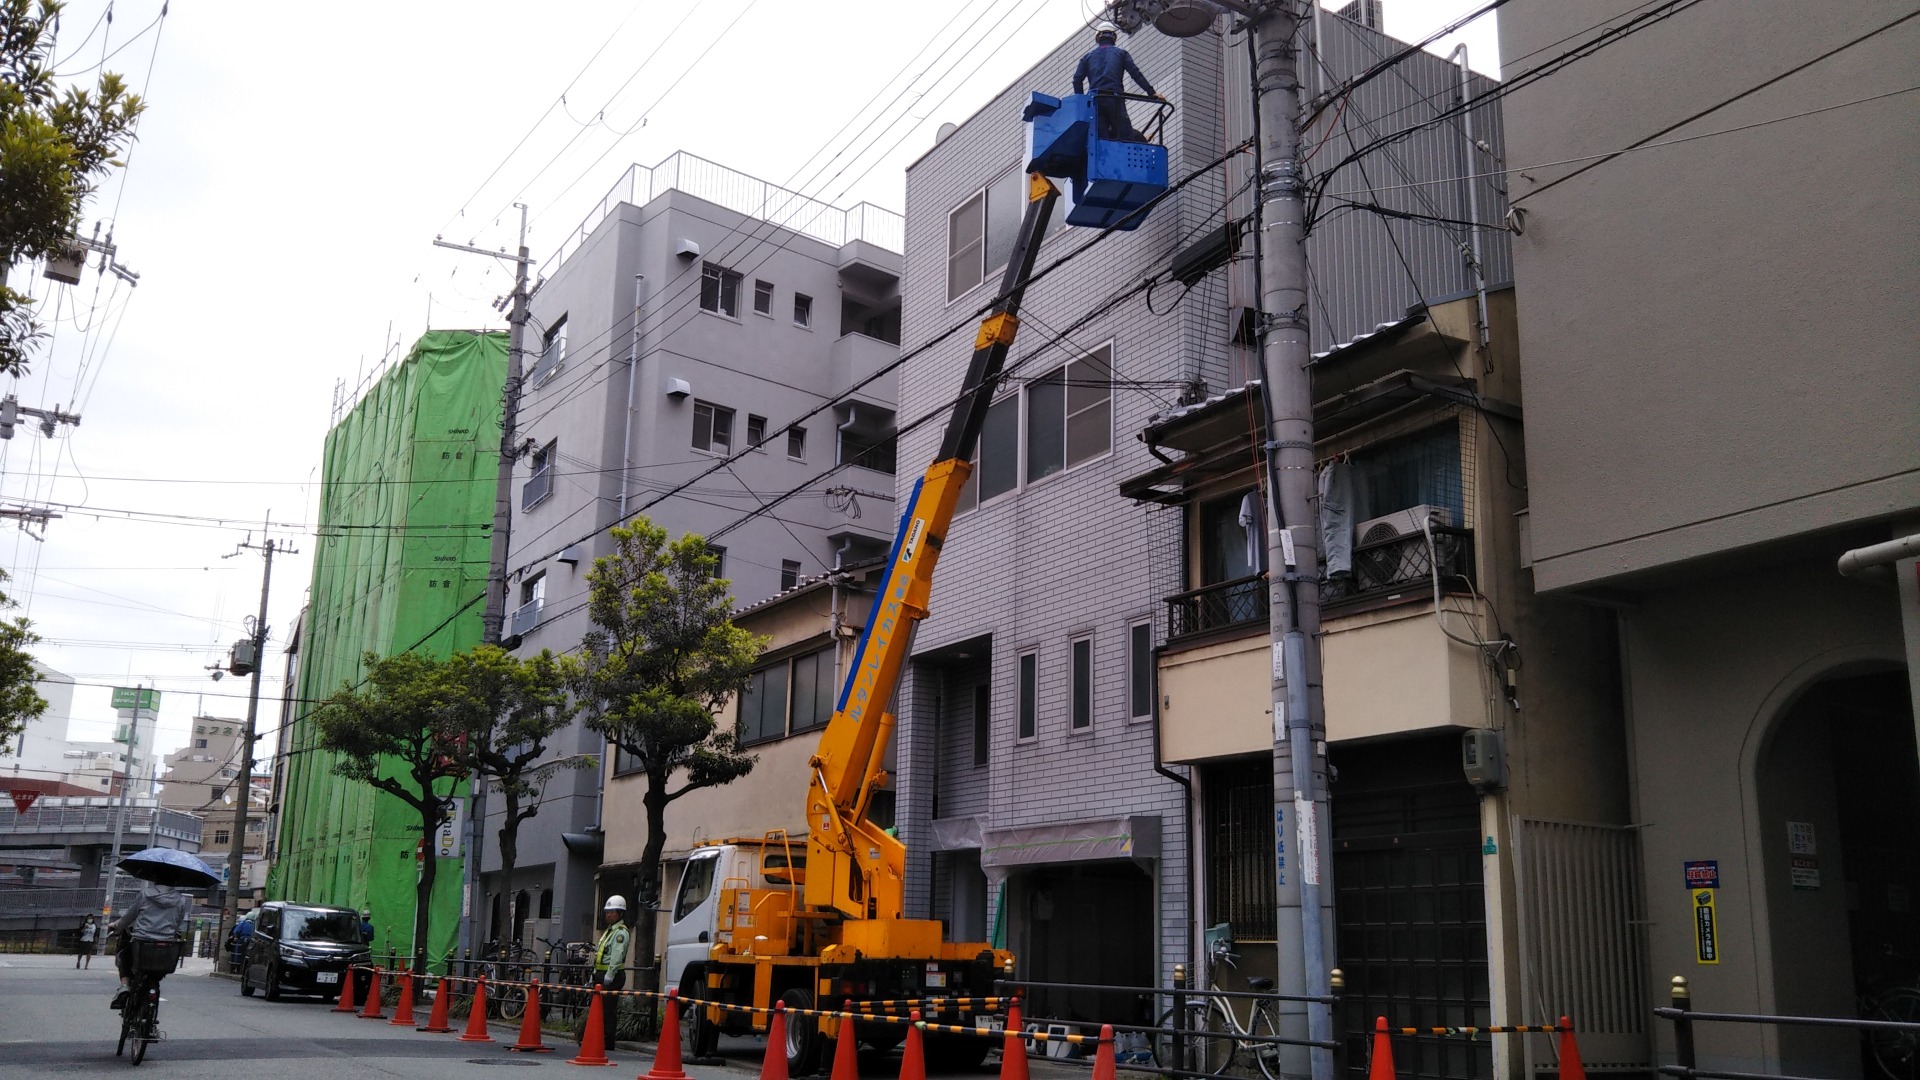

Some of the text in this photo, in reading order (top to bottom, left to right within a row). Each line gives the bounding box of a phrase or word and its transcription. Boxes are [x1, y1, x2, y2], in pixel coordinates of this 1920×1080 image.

[908, 519, 921, 545] TADANO
[1276, 809, 1286, 885] はり紙禁止
